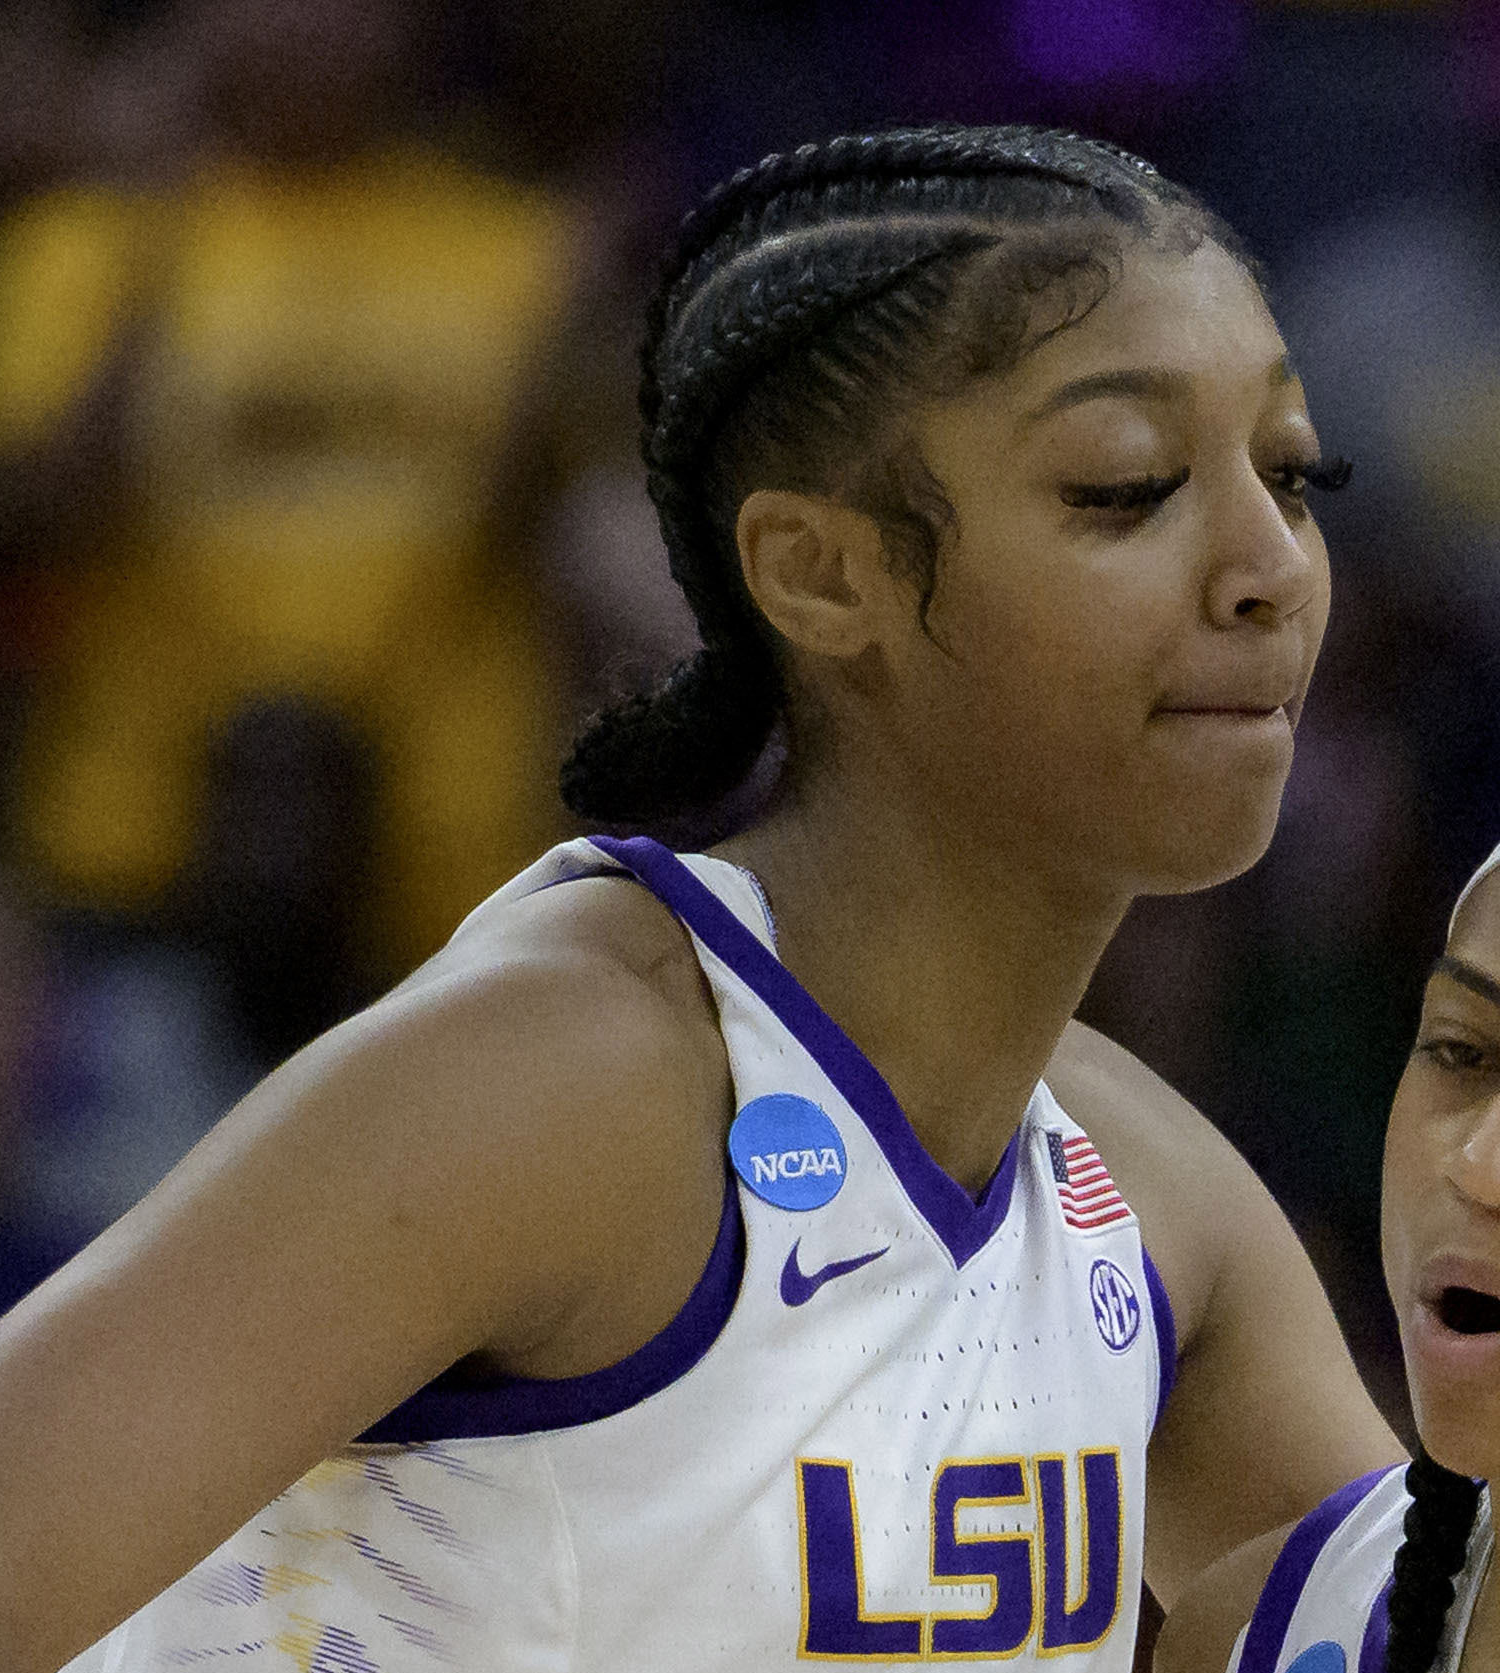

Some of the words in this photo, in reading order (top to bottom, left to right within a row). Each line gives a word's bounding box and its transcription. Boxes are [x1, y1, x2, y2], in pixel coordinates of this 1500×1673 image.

[750, 1148, 843, 1183] NCAA
[1093, 1264, 1138, 1346] SEC
[795, 1446, 1122, 1661] LSU
